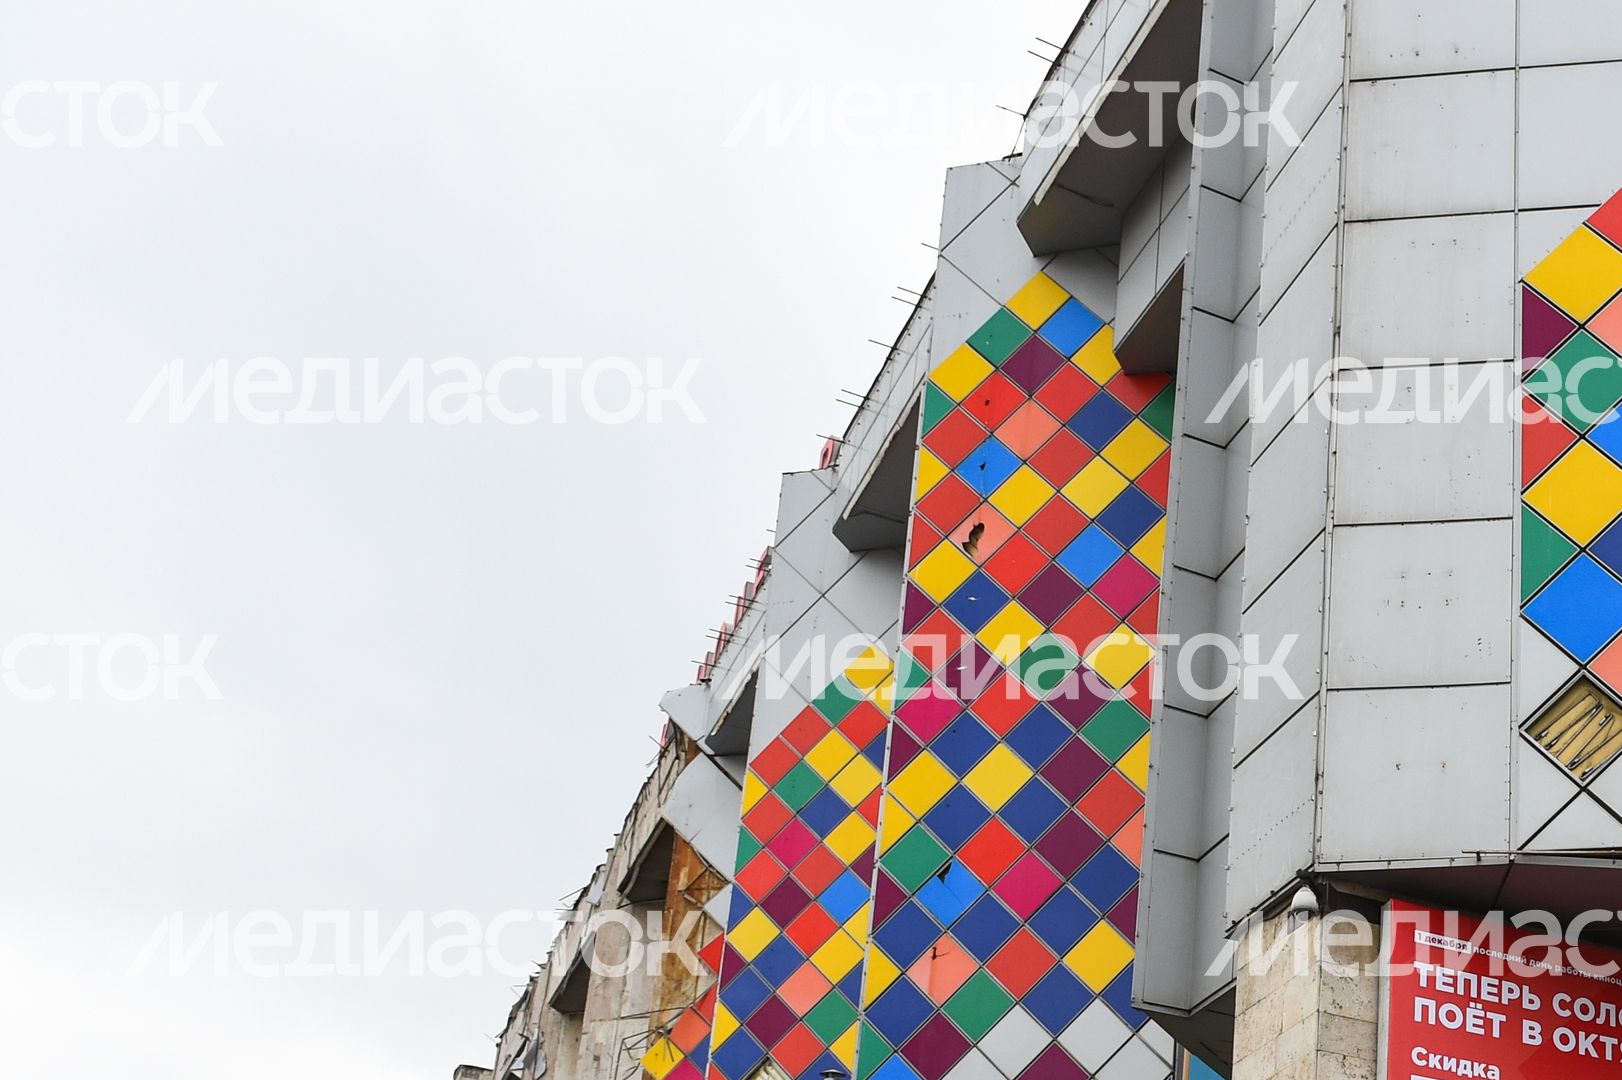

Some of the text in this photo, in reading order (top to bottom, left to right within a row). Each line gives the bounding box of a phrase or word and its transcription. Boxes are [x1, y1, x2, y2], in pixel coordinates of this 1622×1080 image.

[1425, 935, 1468, 951] декабря
[1473, 946, 1527, 964] последний
[1529, 958, 1552, 970] день
[1555, 964, 1591, 978] работы
[1413, 961, 1541, 1011] ТЕПЕРЬ
[1414, 996, 1507, 1038] ПОЁТ
[1522, 1019, 1543, 1046] В
[1411, 1046, 1500, 1080] Скидка
